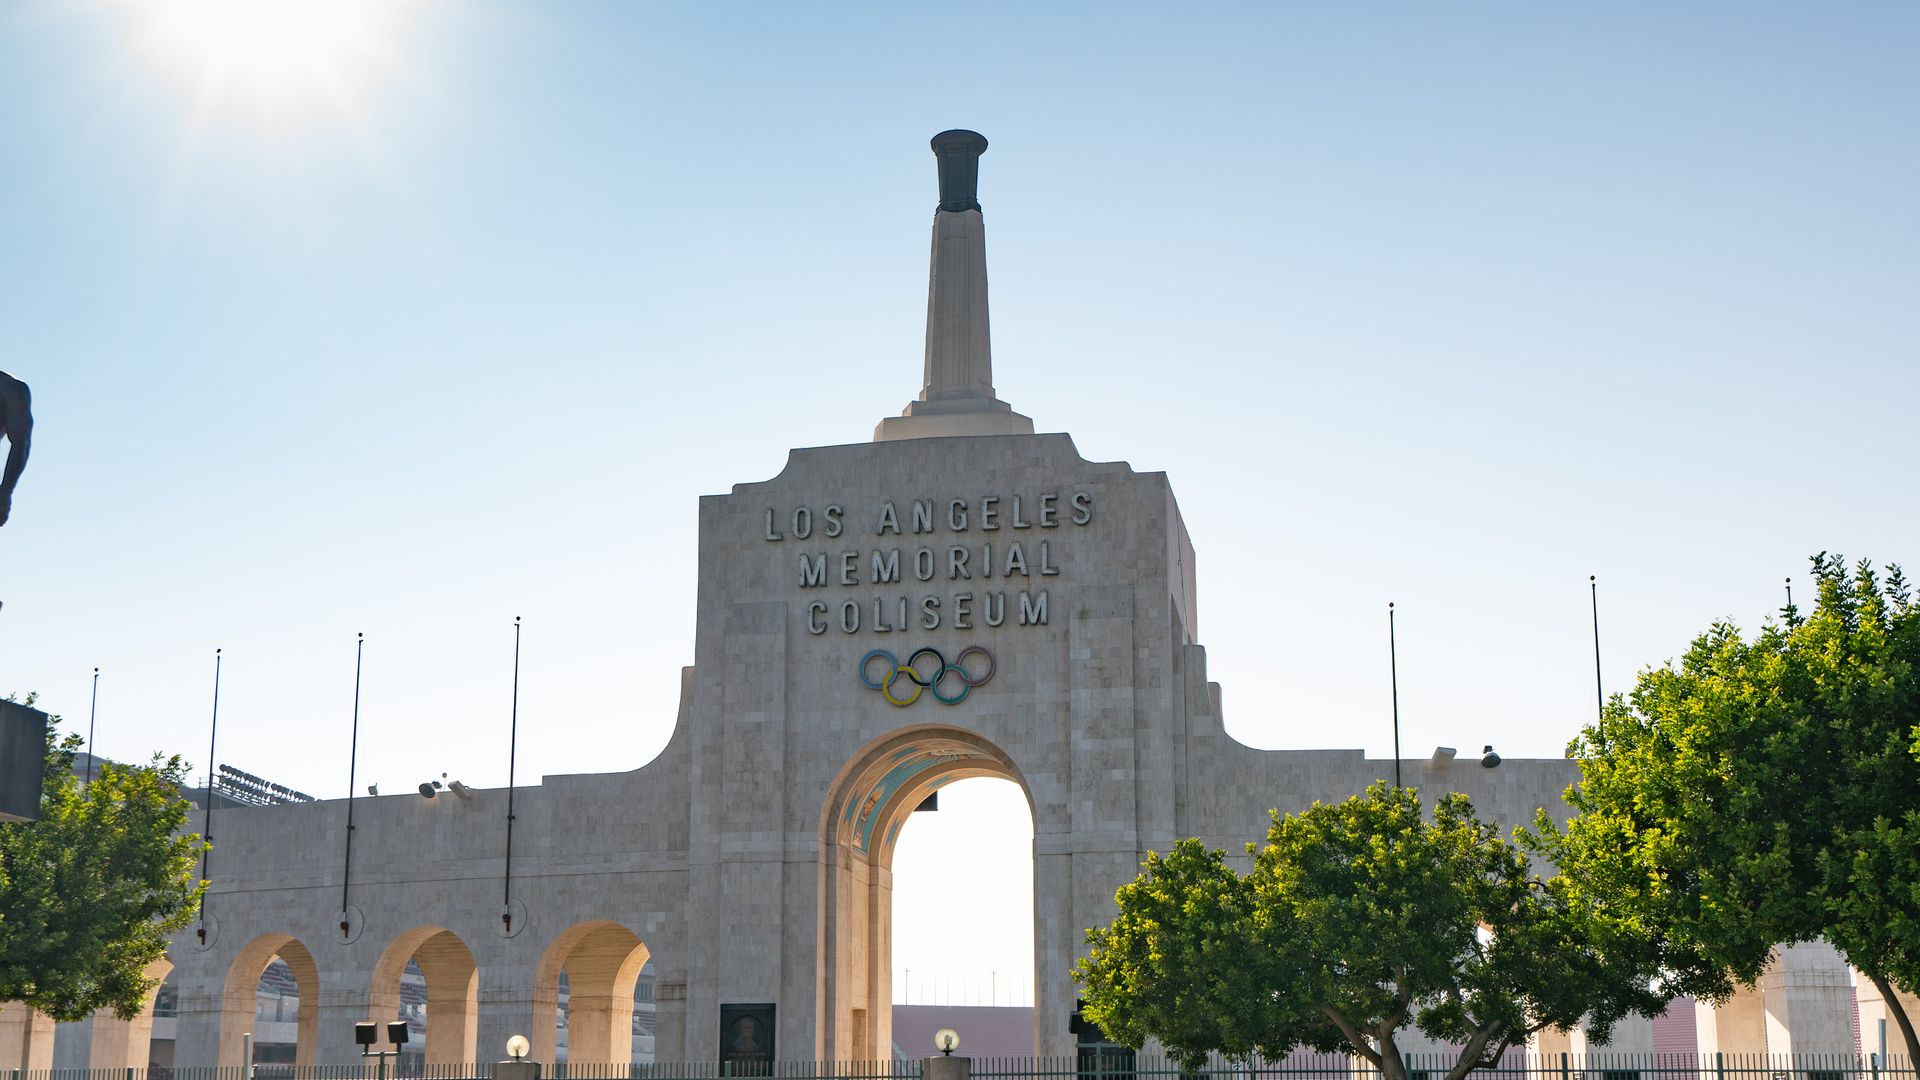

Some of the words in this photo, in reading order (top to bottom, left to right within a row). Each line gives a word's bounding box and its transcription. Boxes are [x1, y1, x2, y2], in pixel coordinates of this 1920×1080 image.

[765, 505, 844, 541] LOS
[876, 492, 1092, 535] ANGELES
[799, 540, 1060, 587] MEMORIAL
[807, 591, 1049, 635] COLISEUM
